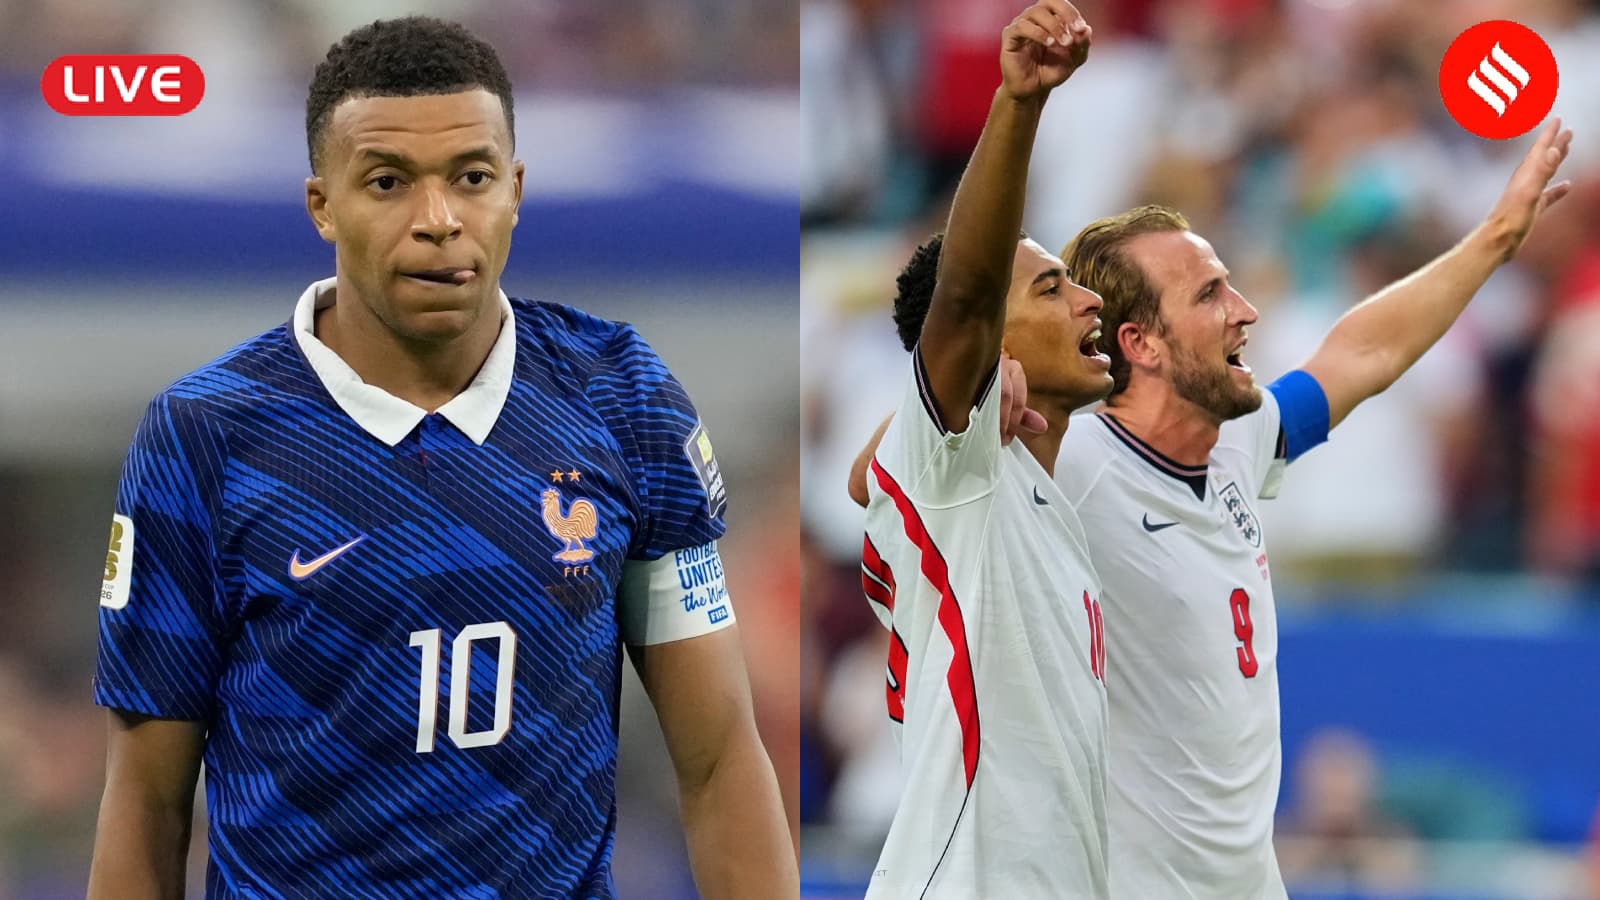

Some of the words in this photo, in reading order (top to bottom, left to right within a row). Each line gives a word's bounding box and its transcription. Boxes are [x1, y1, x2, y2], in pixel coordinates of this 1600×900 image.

[680, 591, 706, 612] the
[710, 607, 728, 622] FIFA
[1083, 589, 1106, 688] 10
[1230, 588, 1258, 679] 9
[409, 621, 517, 753] 10
